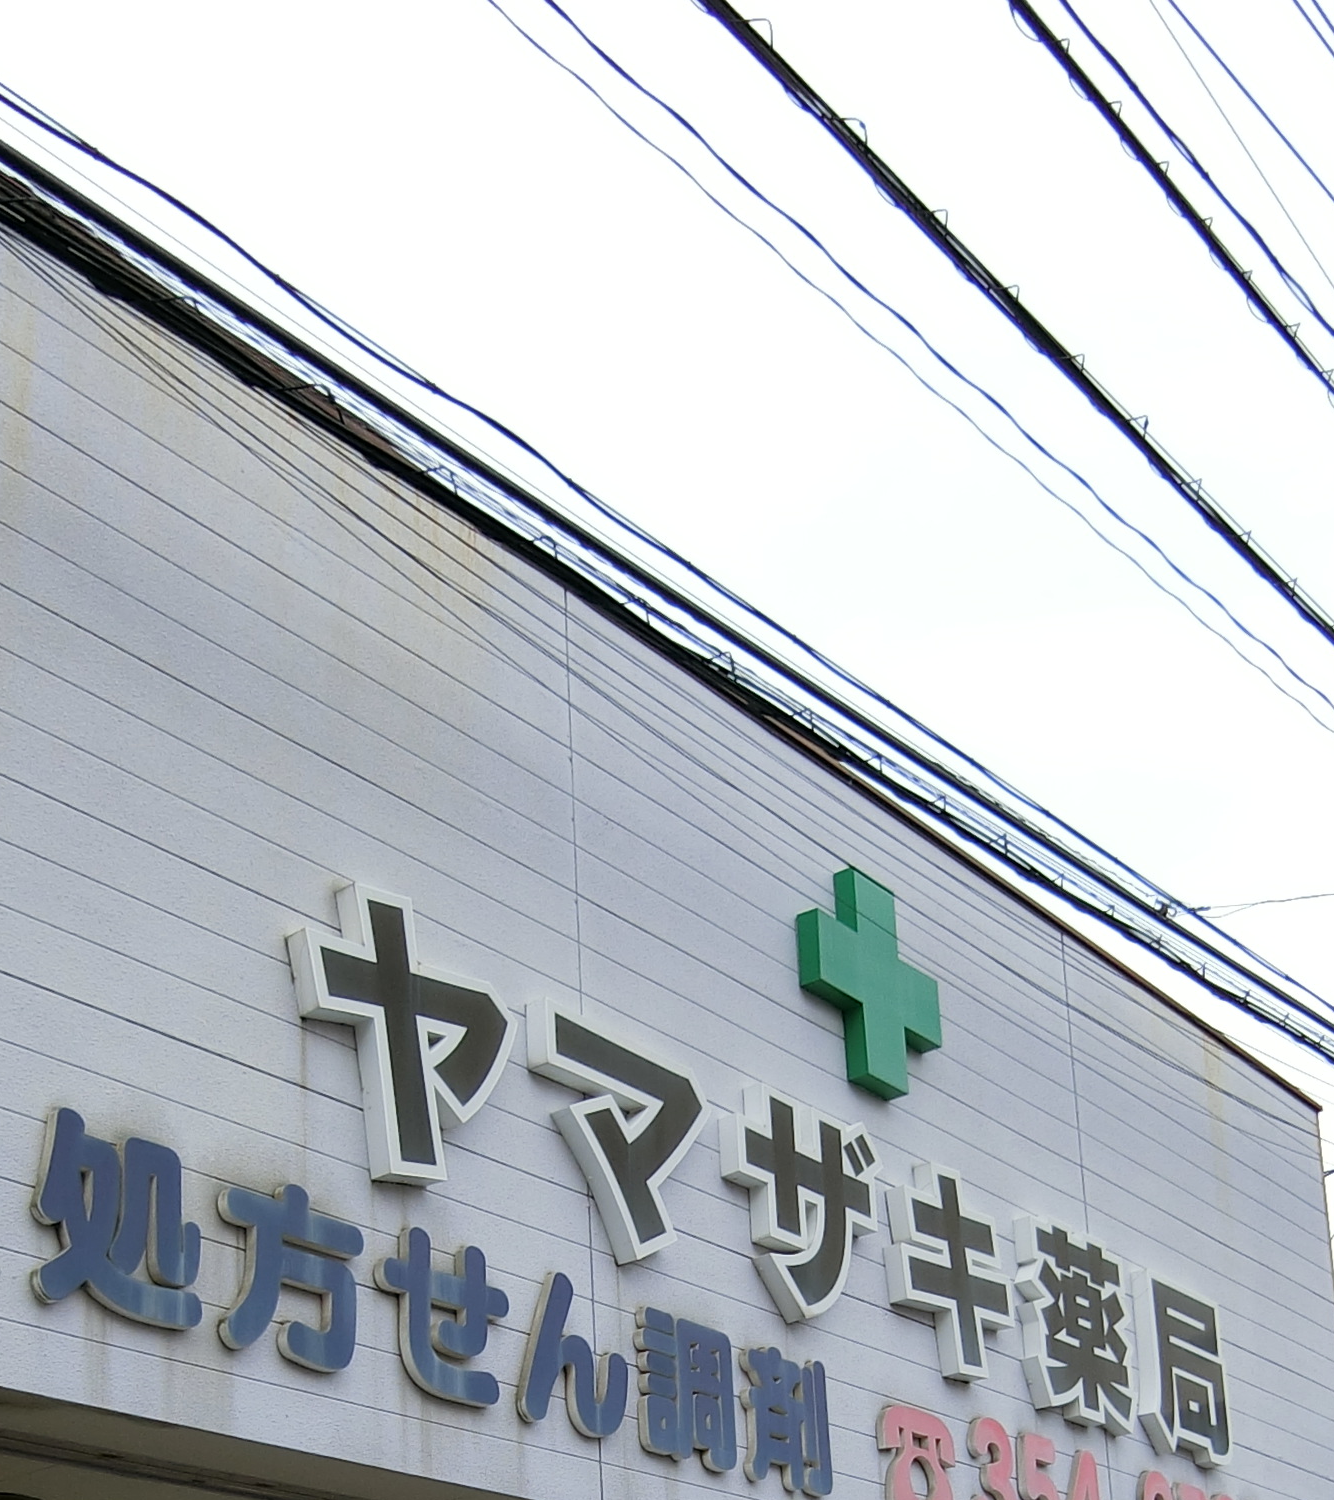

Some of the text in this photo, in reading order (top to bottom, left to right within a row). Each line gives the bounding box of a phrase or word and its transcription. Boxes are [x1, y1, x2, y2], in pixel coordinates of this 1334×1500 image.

[29, 1106, 833, 1498] 処方せん調剤
[289, 882, 1233, 1468] ヤマザキ薬局
